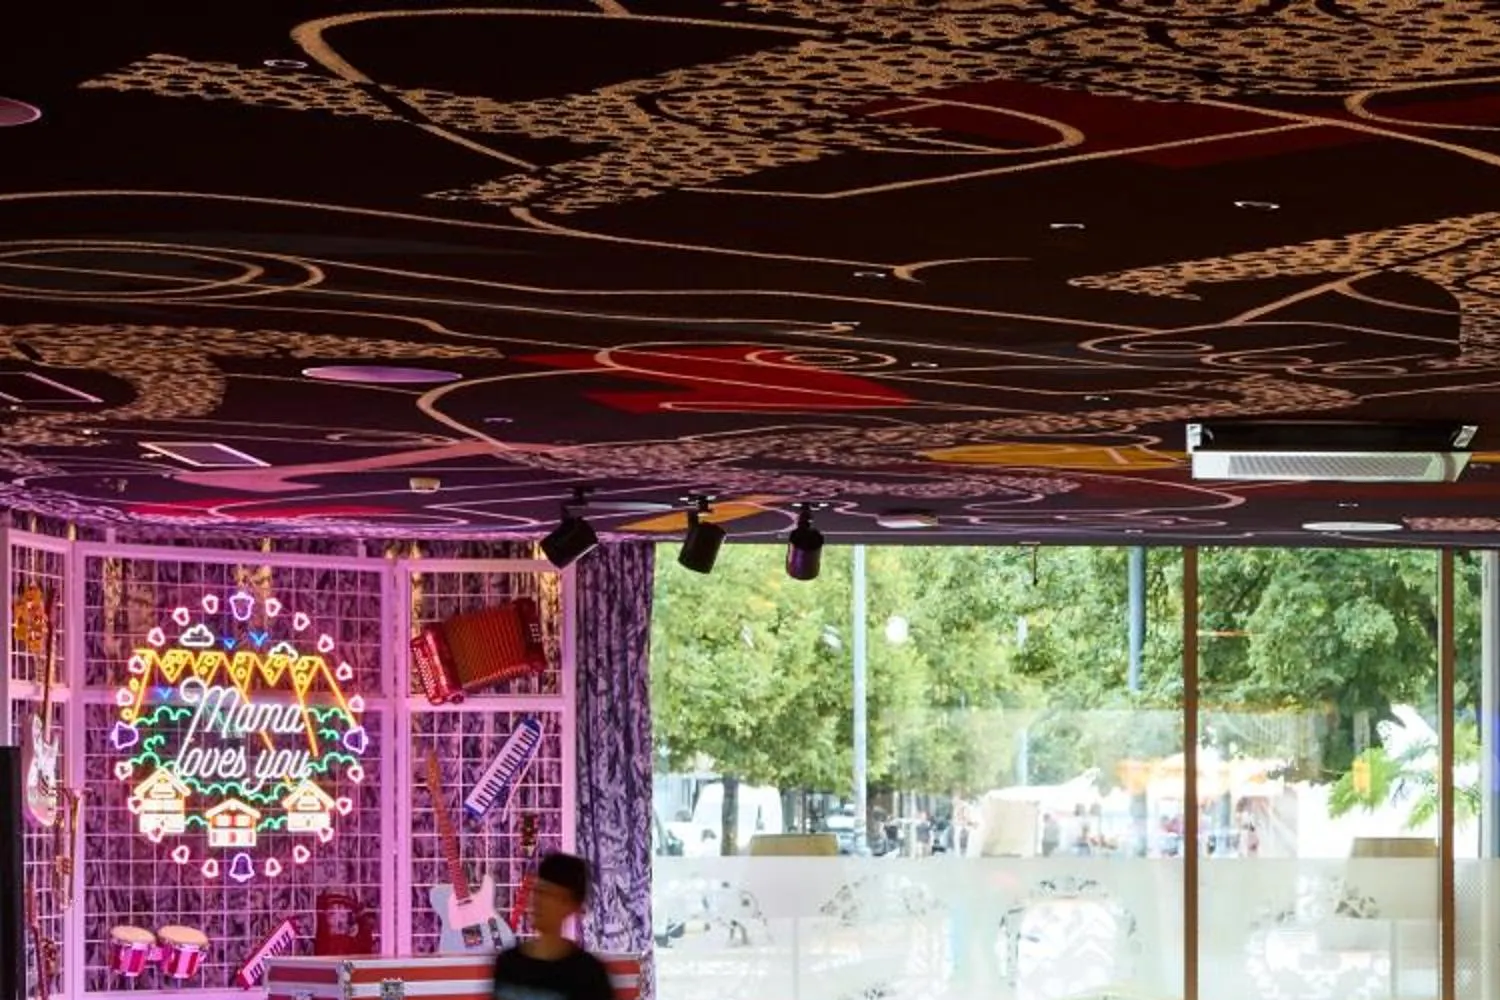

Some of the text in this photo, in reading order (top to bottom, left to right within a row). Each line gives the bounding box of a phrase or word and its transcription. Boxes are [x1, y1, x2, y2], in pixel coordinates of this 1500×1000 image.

[179, 676, 305, 739] Mama
[173, 737, 313, 795] loves you
